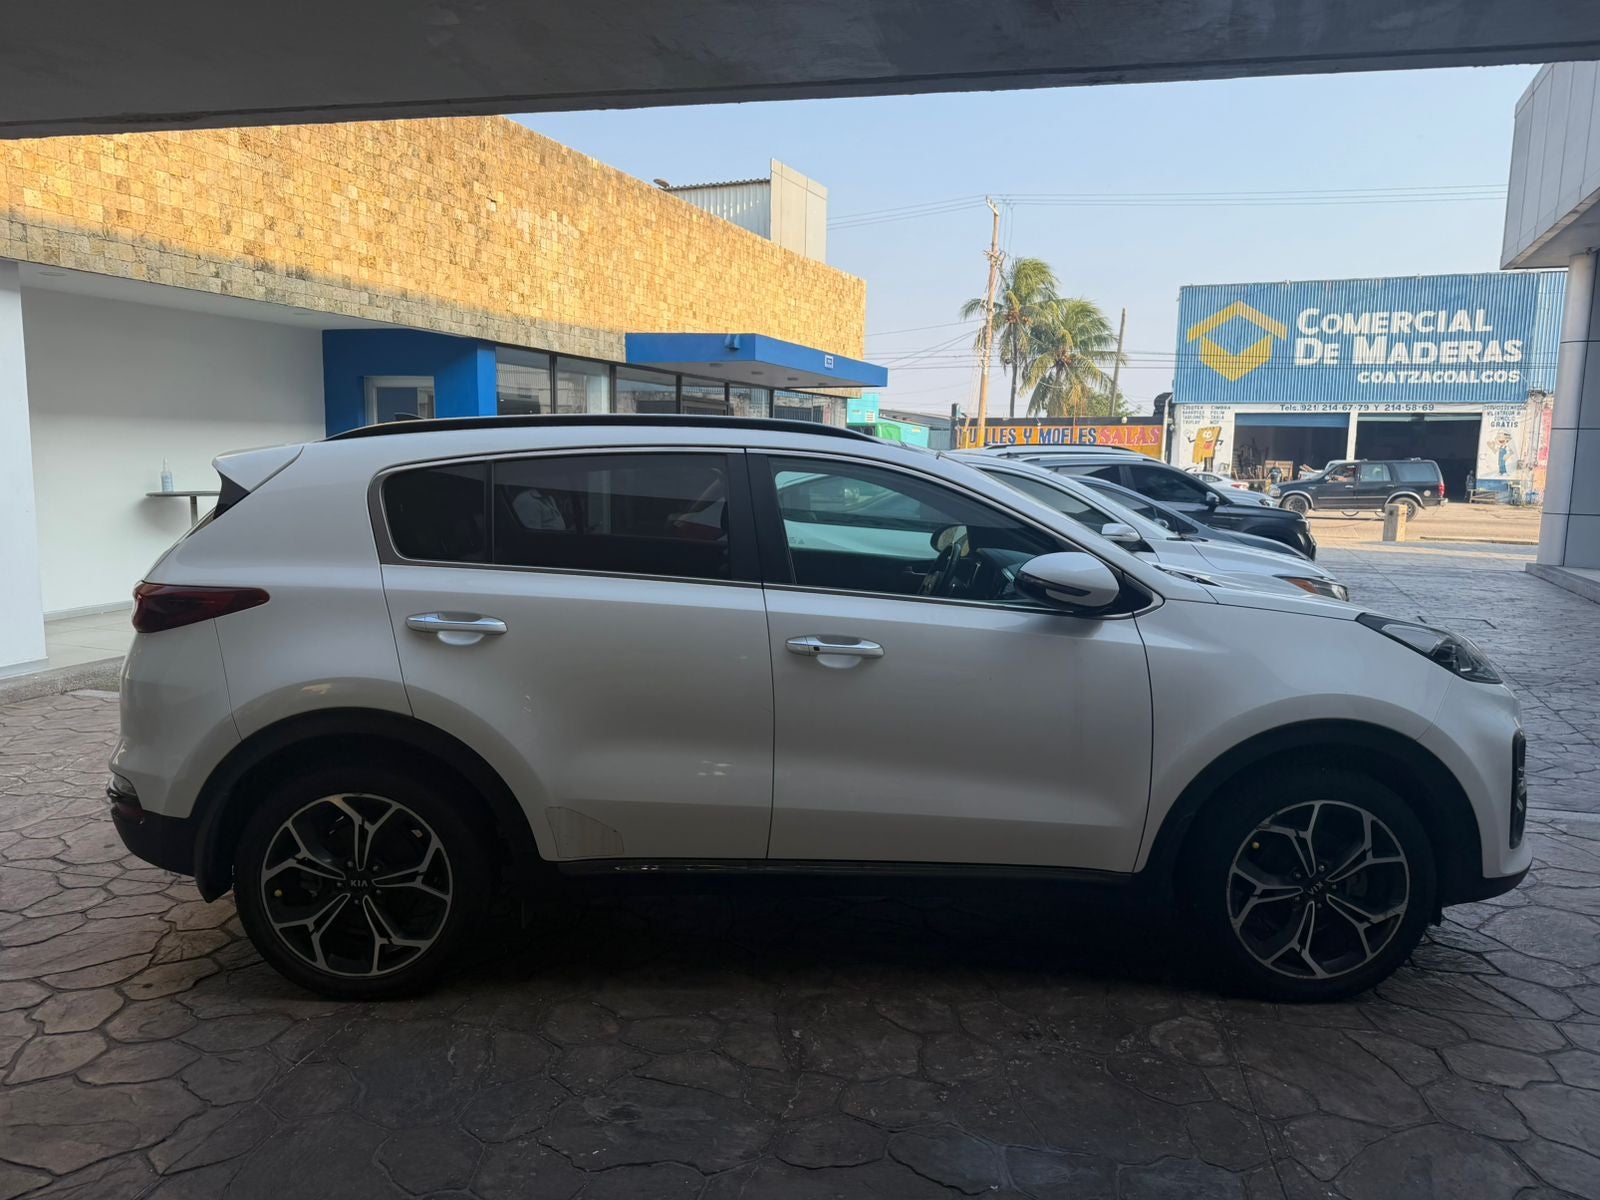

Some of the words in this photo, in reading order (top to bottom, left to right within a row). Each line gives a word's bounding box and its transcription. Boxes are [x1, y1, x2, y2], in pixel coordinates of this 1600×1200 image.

[1297, 308, 1493, 335] COMERCIAL
[1295, 337, 1339, 366] DE
[1352, 335, 1523, 365] MADERAS
[1357, 369, 1521, 384] COATZACOALCOS
[1023, 428, 1033, 444] Y
[1098, 426, 1160, 446] SALAS
[350, 879, 369, 888] KIA
